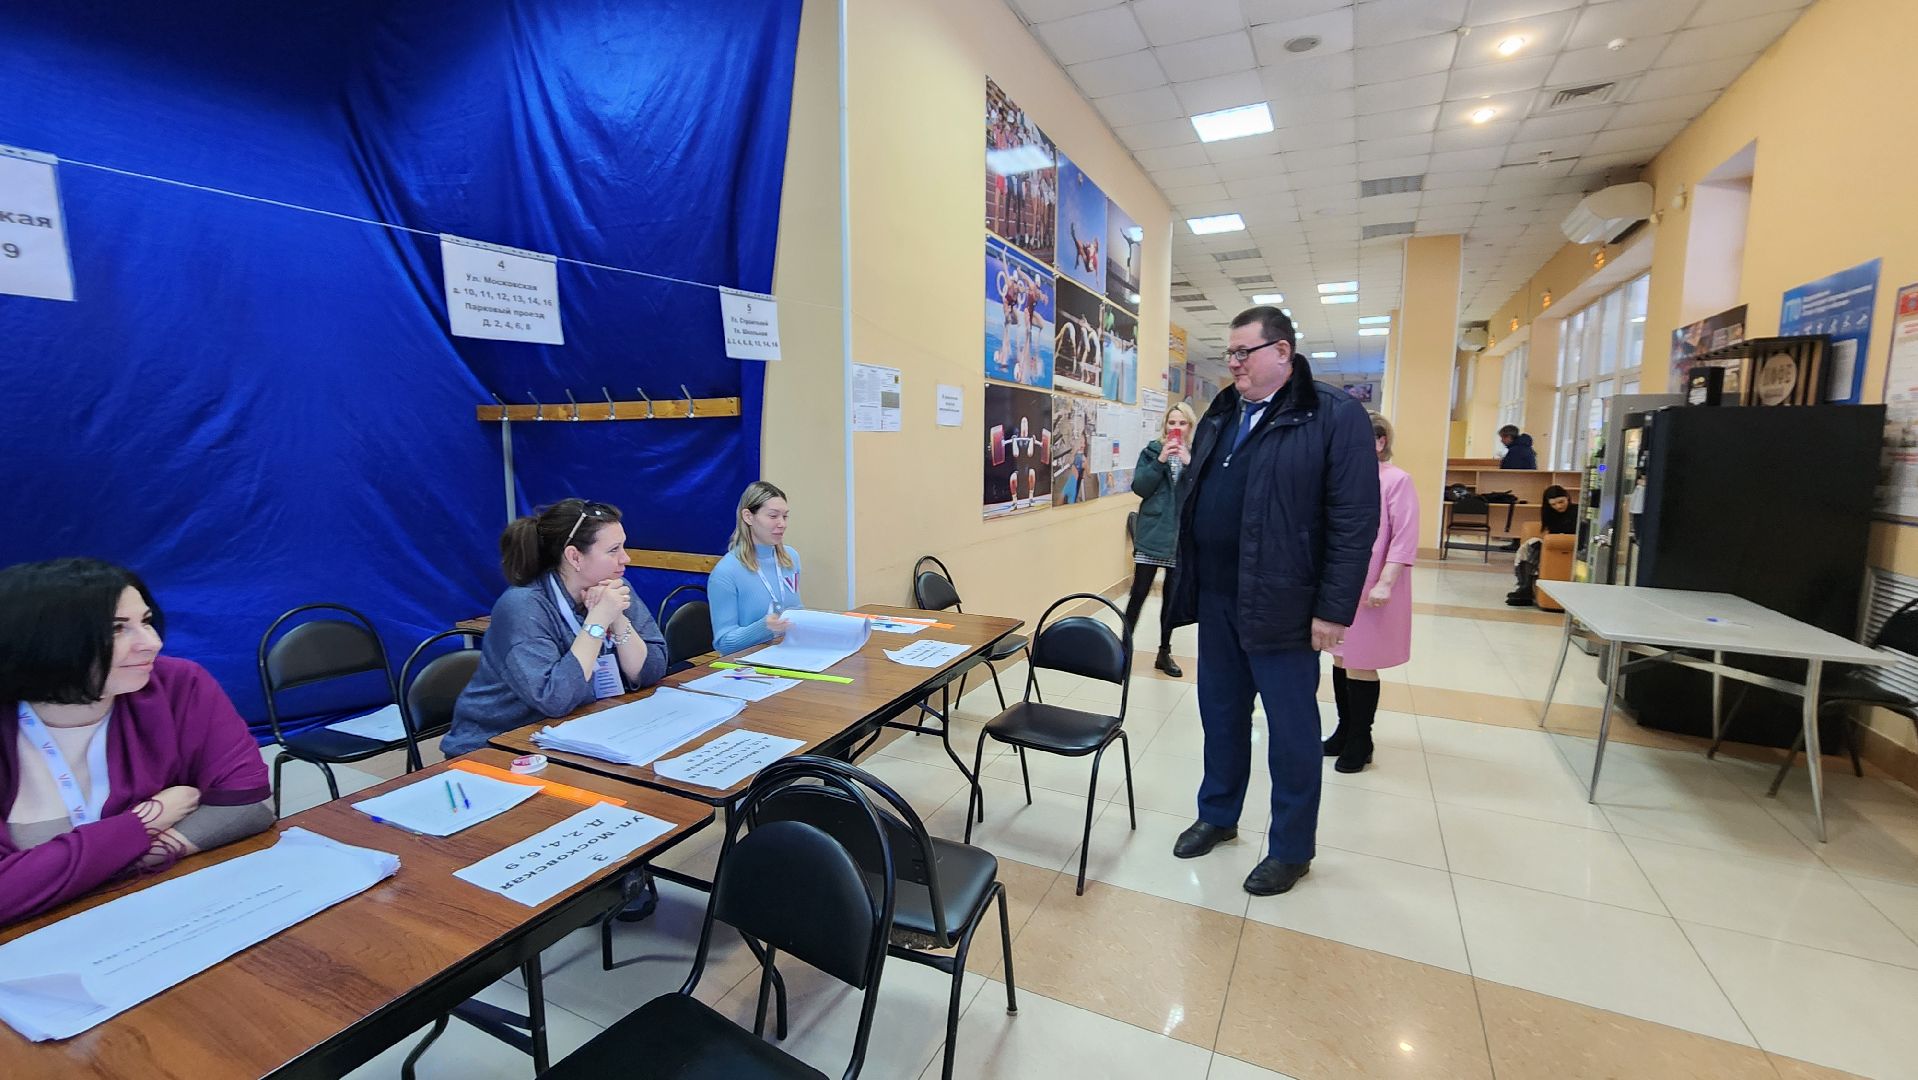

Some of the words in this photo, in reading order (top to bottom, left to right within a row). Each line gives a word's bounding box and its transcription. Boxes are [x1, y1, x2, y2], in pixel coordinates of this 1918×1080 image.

[2, 242, 20, 259] 9
[497, 260, 505, 270] 4
[483, 276, 538, 291] Московская
[480, 290, 494, 300] 11,
[497, 292, 510, 302] 12,
[513, 295, 526, 304] 13,
[528, 297, 541, 306] 14,
[465, 302, 511, 315] Парковый
[513, 310, 545, 319] проезд
[747, 303, 752, 312] 5
[541, 840, 562, 849] 4,
[499, 831, 616, 890] Московская
[519, 850, 542, 860] 6,
[591, 853, 609, 861] 3
